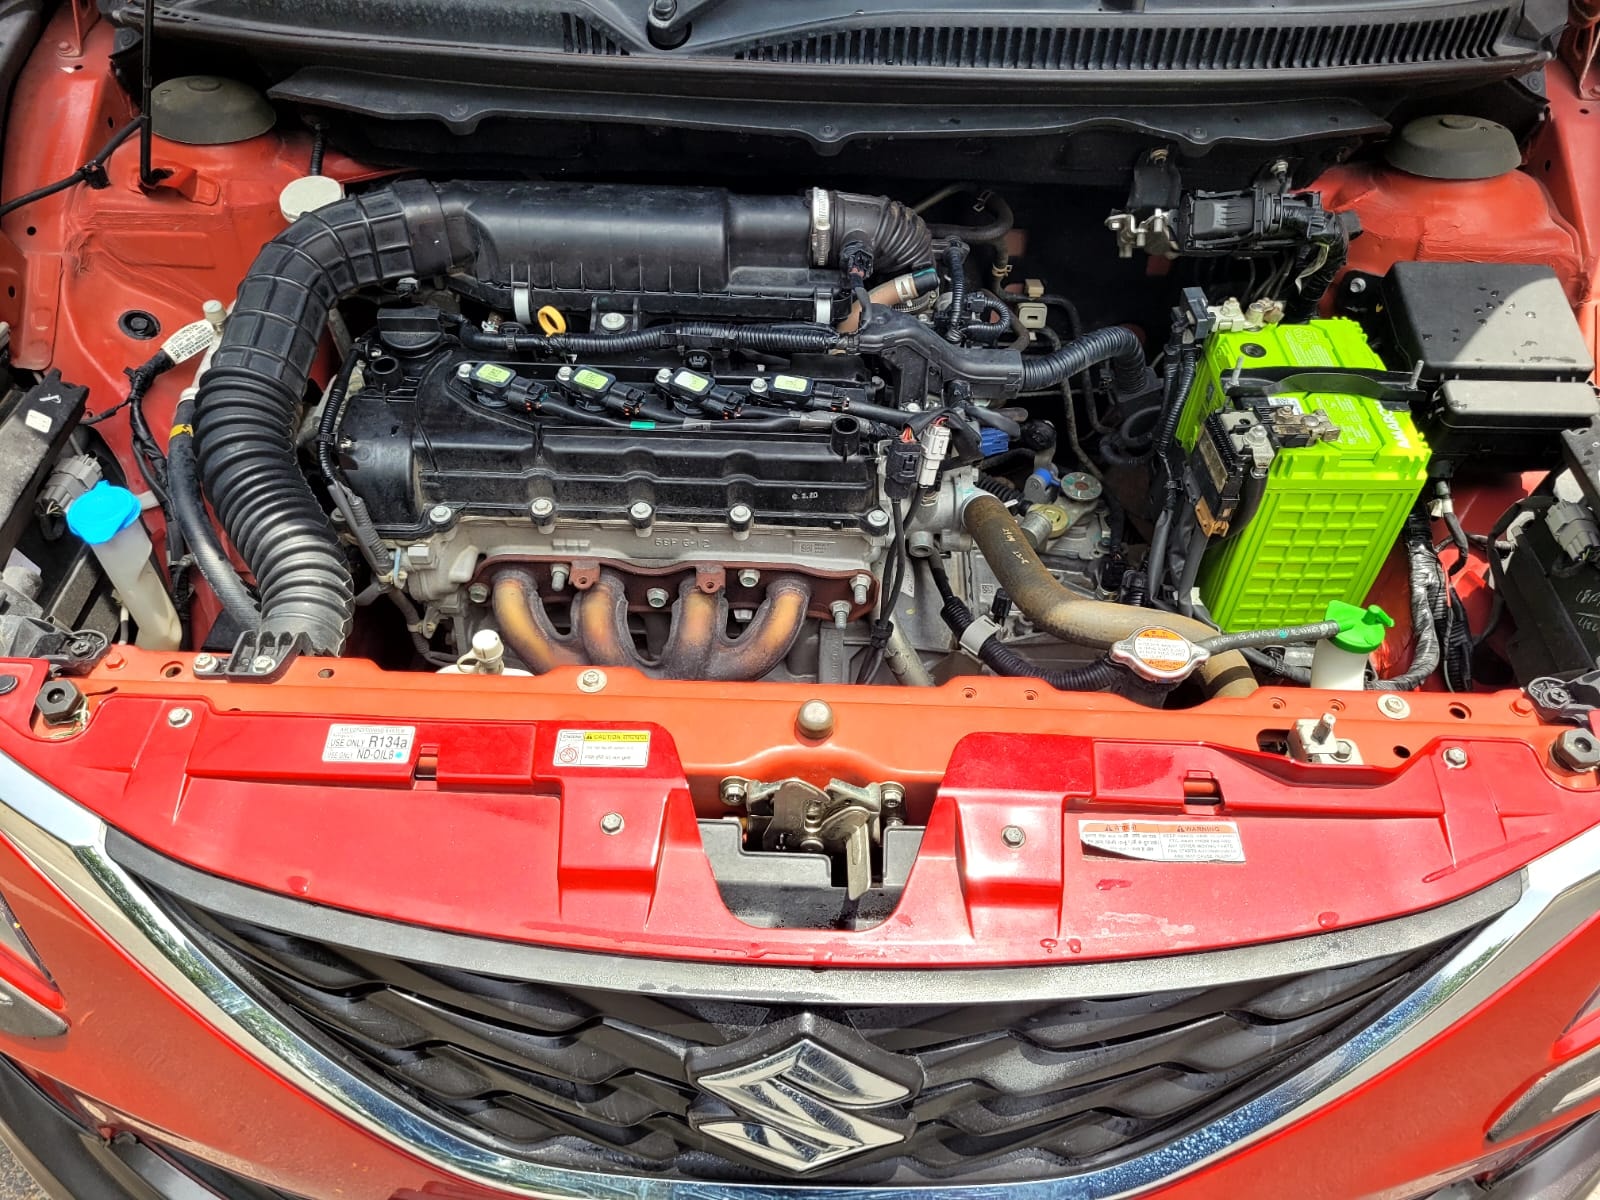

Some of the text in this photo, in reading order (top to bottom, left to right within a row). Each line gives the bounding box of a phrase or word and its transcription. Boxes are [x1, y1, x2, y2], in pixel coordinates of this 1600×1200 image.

[1374, 399, 1411, 448] AMARO
[330, 735, 408, 748] USE ONLY R134a
